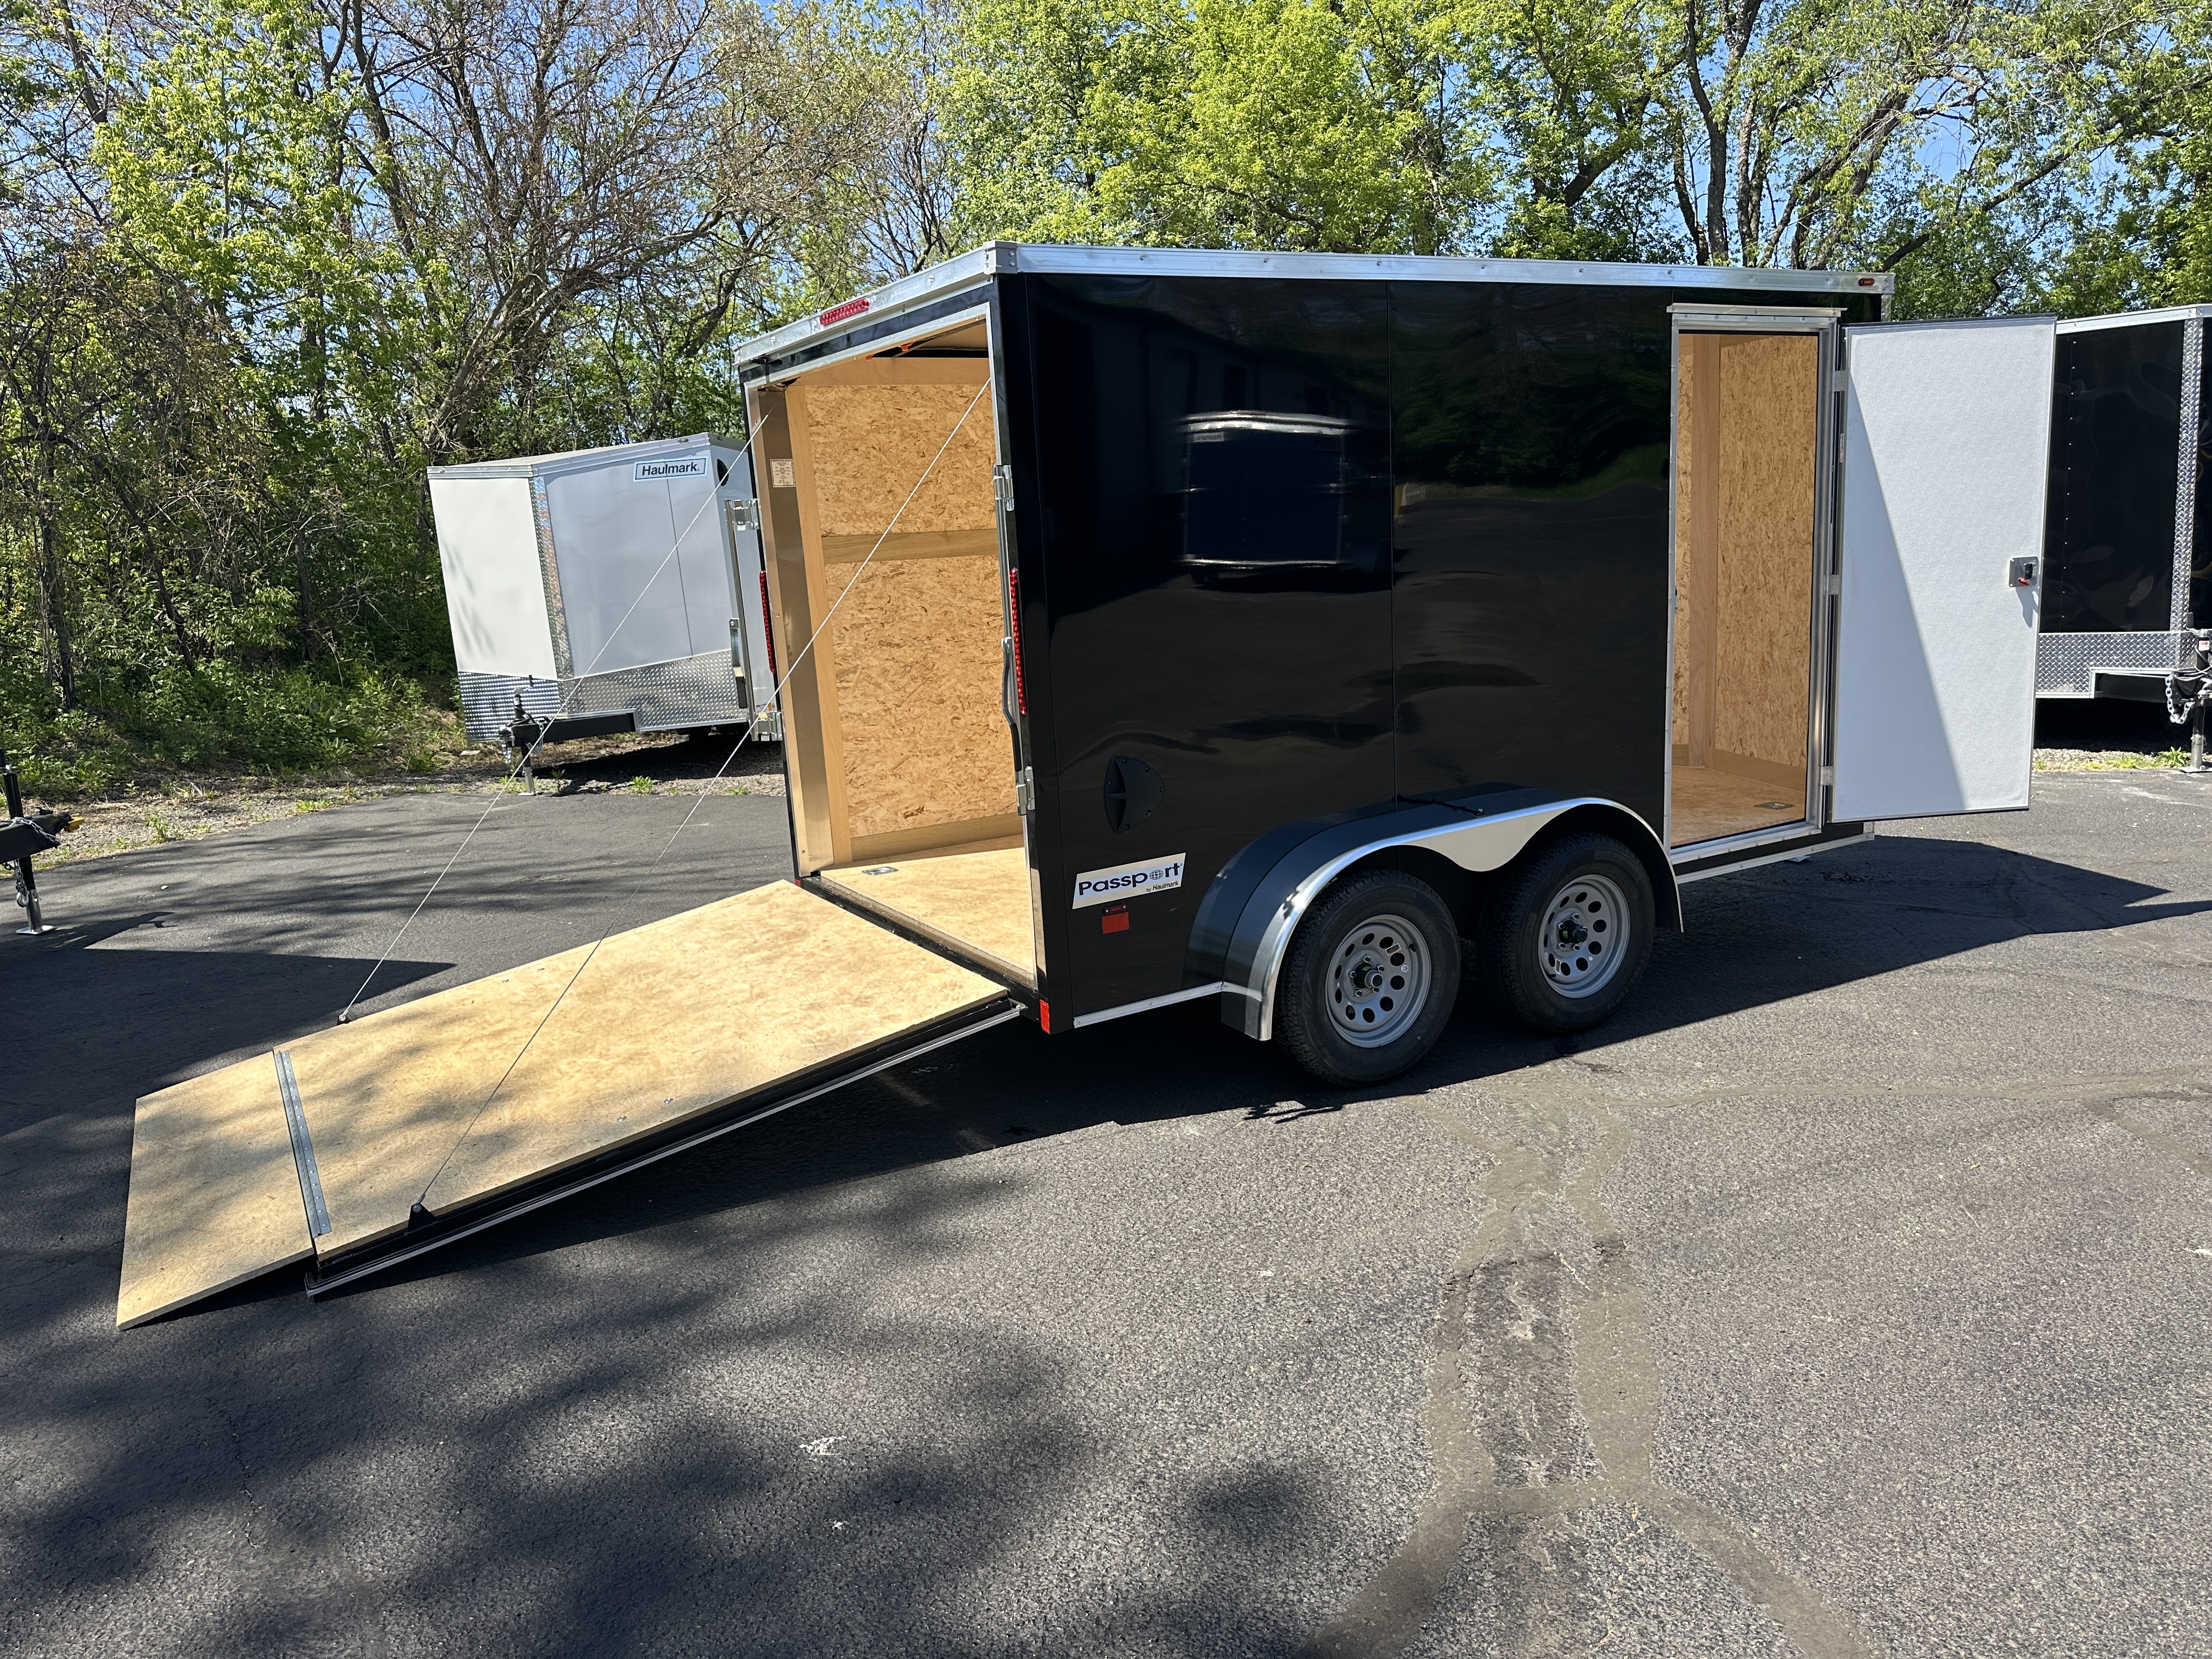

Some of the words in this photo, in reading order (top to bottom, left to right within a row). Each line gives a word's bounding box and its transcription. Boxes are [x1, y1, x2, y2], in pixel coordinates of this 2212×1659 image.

[642, 462, 697, 476] Haulmark
[1079, 863, 1180, 895] Passport
[1152, 879, 1179, 891] Haulmark
